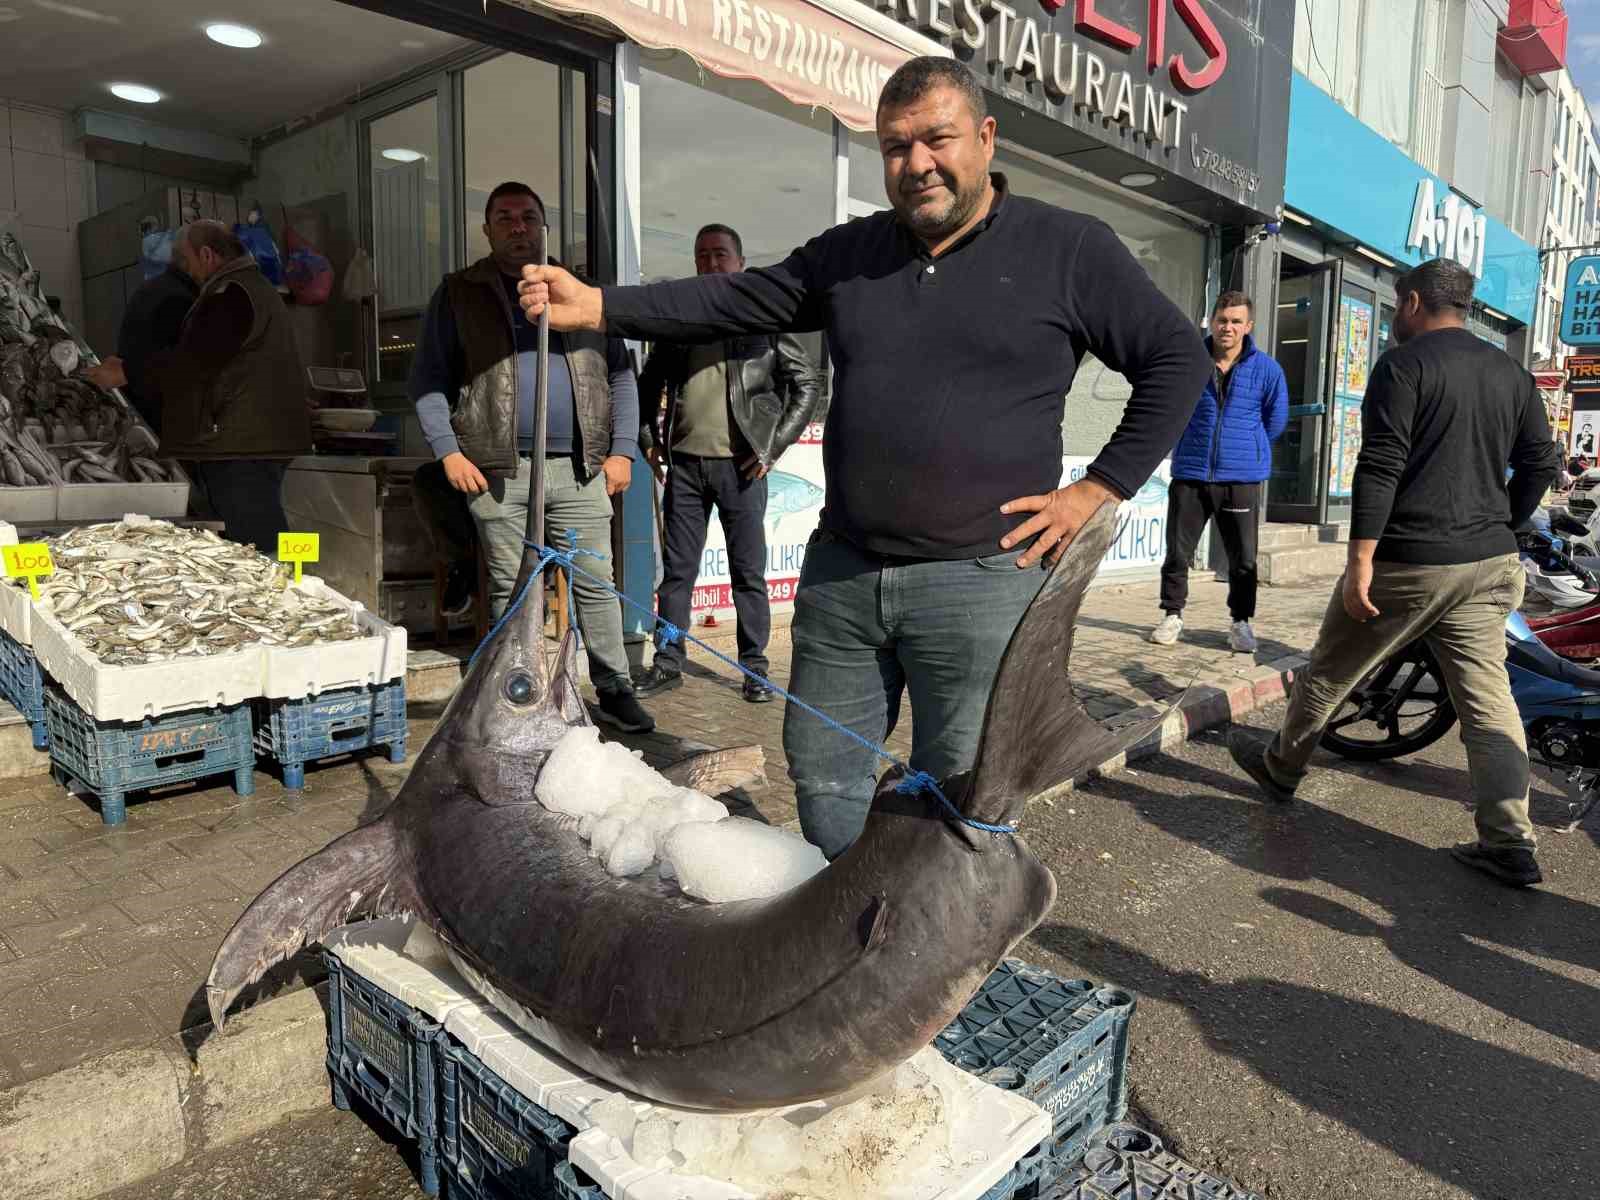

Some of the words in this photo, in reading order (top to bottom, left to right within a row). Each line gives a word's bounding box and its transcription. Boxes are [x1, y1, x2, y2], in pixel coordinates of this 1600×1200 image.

[885, 0, 1188, 149] ESTAURANT
[282, 540, 312, 554] 100
[13, 551, 50, 570] 100
